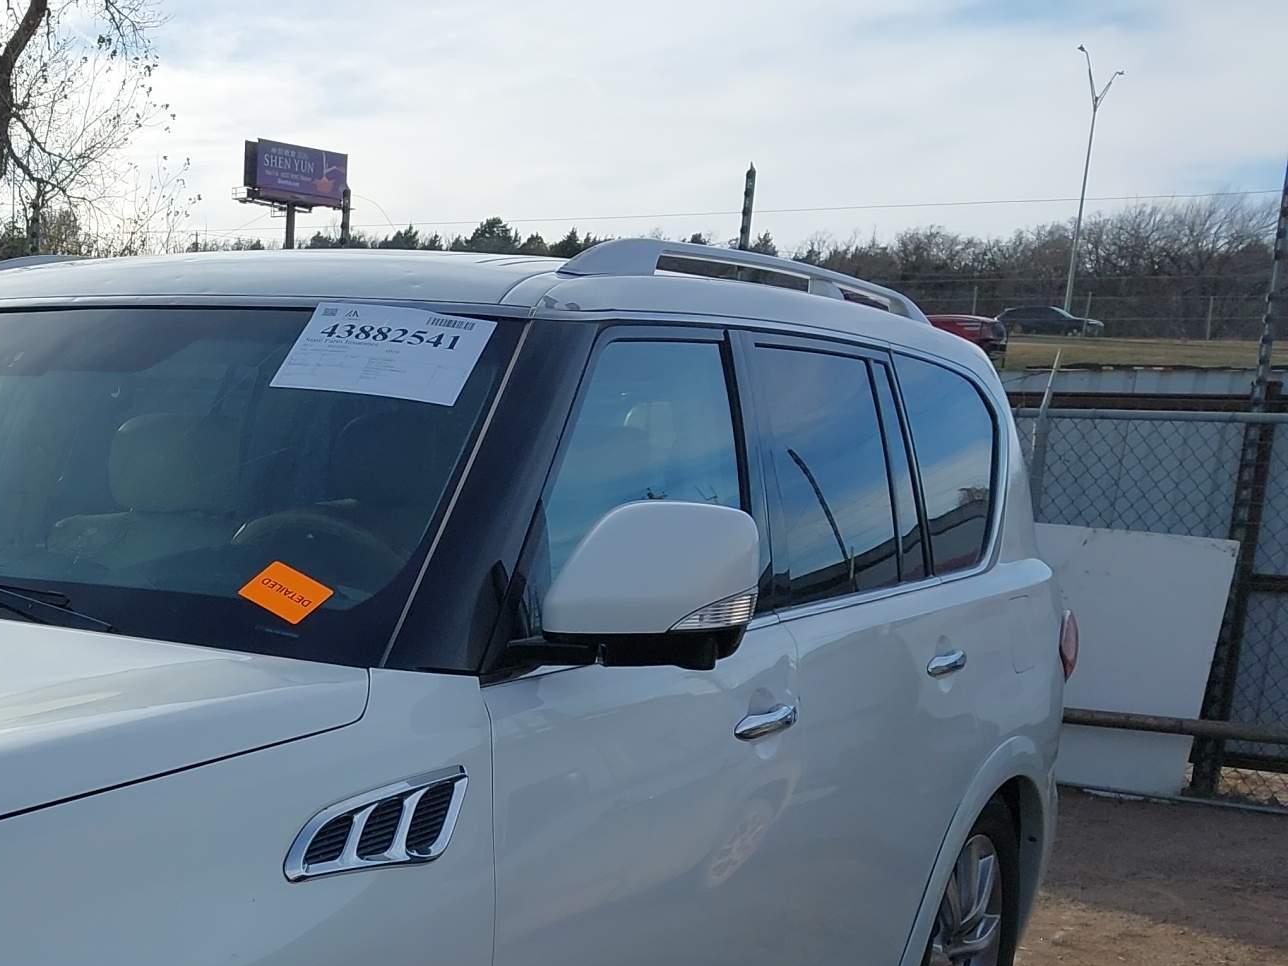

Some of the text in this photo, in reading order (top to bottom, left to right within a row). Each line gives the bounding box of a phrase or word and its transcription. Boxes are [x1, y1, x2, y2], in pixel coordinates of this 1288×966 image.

[263, 153, 291, 170] SHEN
[294, 159, 314, 173] YUN
[320, 323, 460, 350] 43882541
[261, 577, 312, 608] DETAILED
